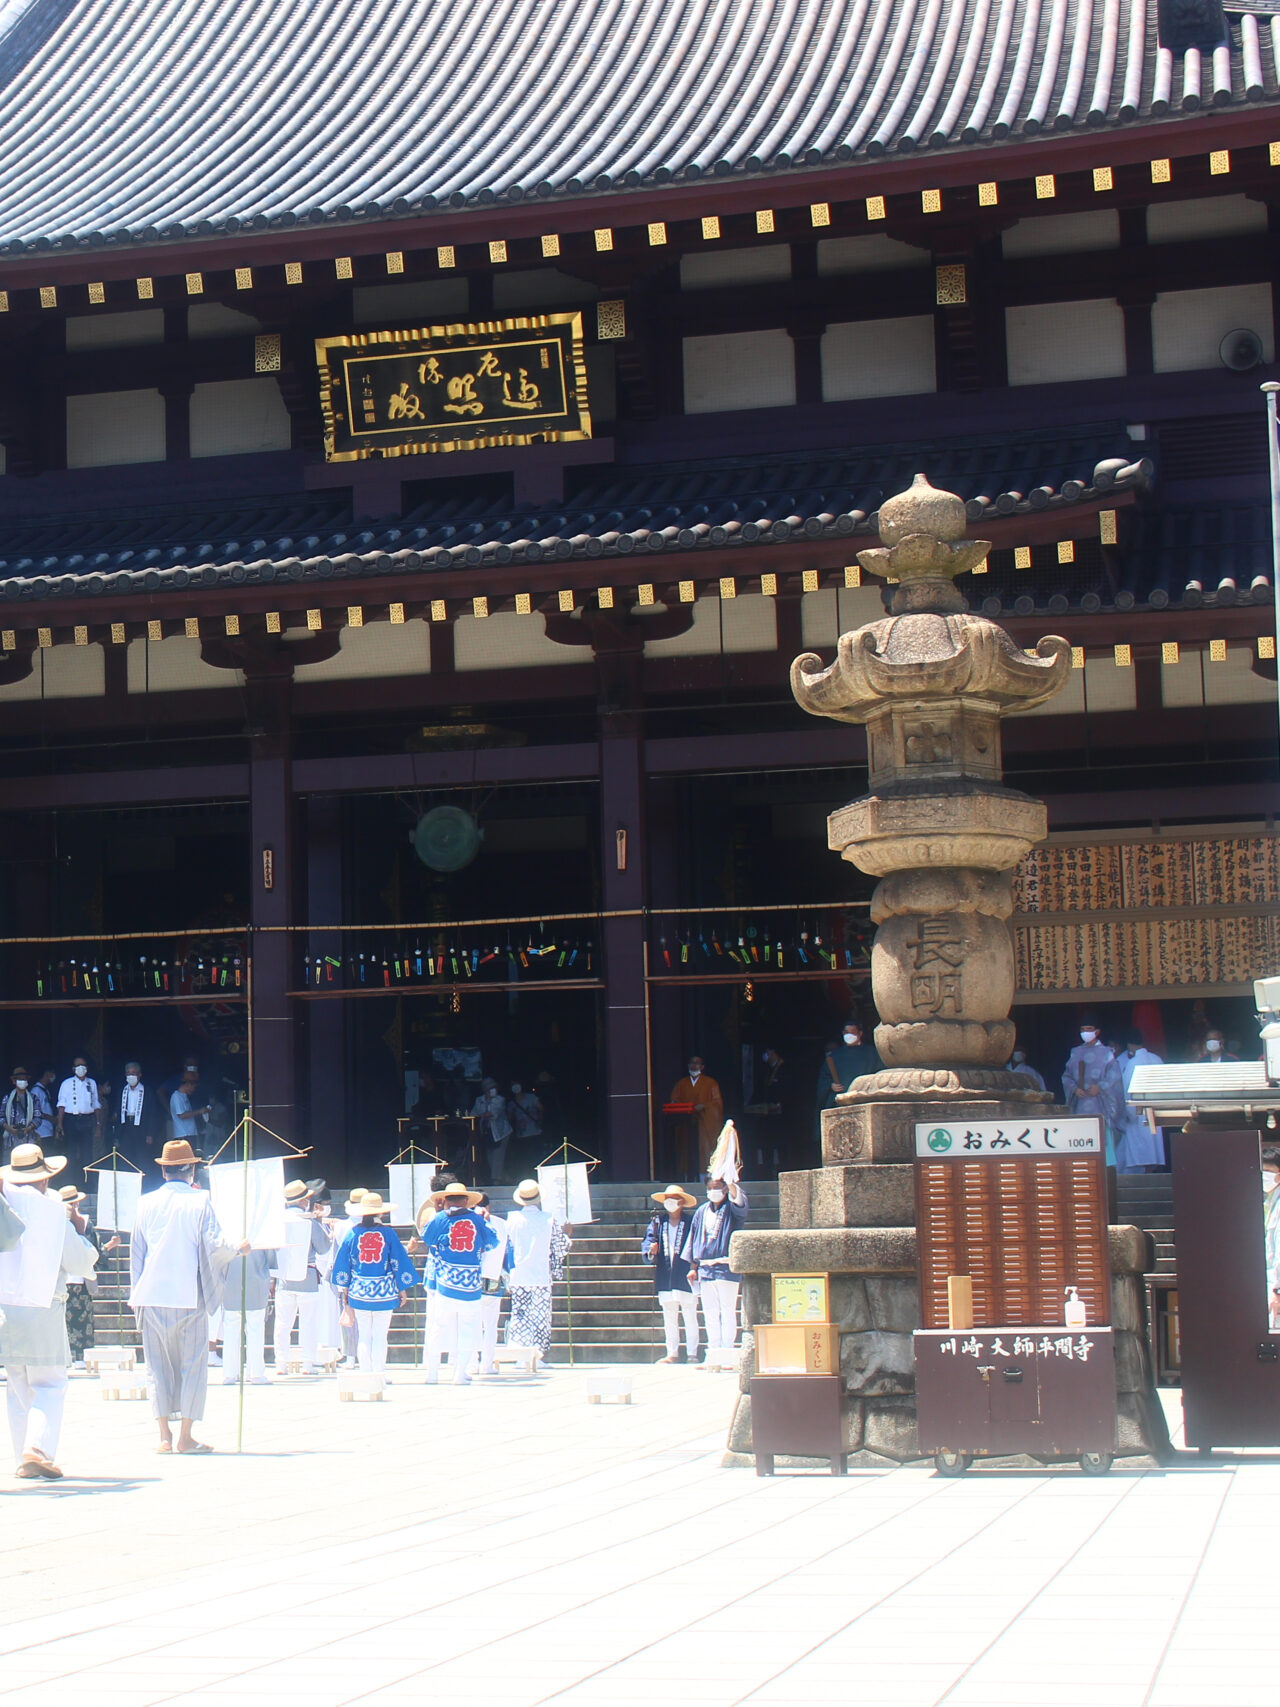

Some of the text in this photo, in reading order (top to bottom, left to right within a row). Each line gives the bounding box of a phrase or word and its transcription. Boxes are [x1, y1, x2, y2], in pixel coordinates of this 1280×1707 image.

[964, 1128, 1058, 1149] おみくじ
[1068, 1138, 1094, 1148] 100円
[358, 1231, 384, 1263] 祭
[450, 1219, 476, 1251] 祭
[812, 1332, 822, 1369] おみくじ
[940, 1335, 1095, 1362] 川崎大師平間寺
